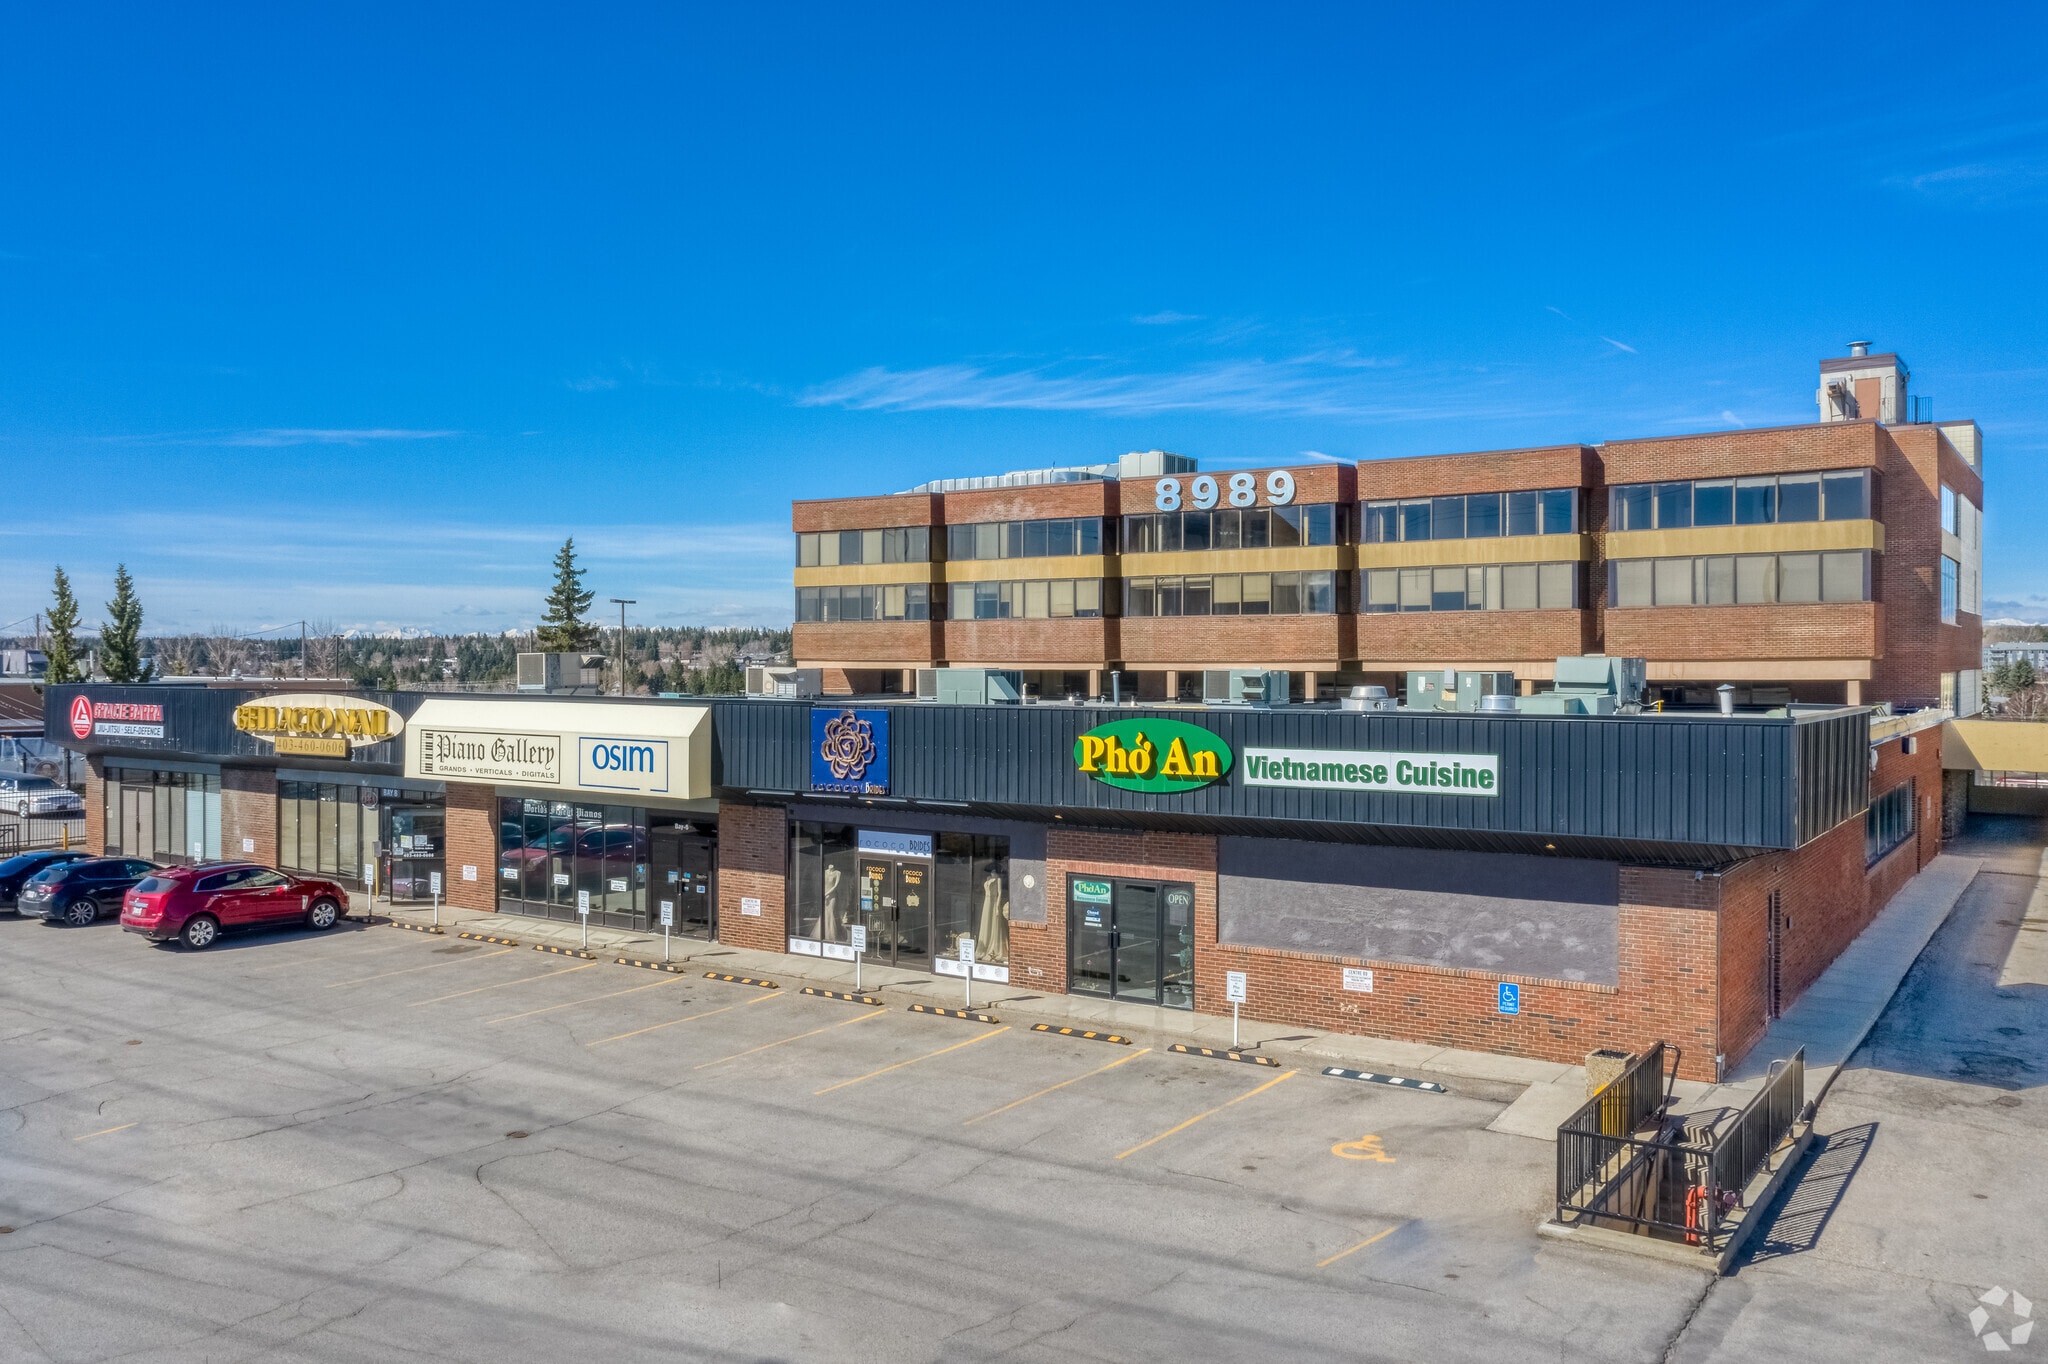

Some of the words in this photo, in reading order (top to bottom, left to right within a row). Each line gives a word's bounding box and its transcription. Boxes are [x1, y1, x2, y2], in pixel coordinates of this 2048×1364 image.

[1155, 470, 1295, 511] 8989
[93, 703, 128, 720] GRACIE
[129, 704, 163, 721] BARRA
[235, 706, 334, 734] BELLAGIO
[124, 726, 161, 736] SELF-DEFENCE
[277, 738, 344, 754] 403-460-0606
[436, 734, 485, 763] Piano
[491, 737, 555, 771] Gallery
[1160, 737, 1219, 777] An
[439, 765, 467, 773] GRANDS
[475, 768, 513, 776] VERTICALS
[521, 771, 555, 779] DIGITALS
[1245, 755, 1389, 785] Vietnamese
[1396, 760, 1495, 789] Cuisine
[909, 840, 931, 852] BRIDES
[1168, 893, 1189, 905] OPEN
